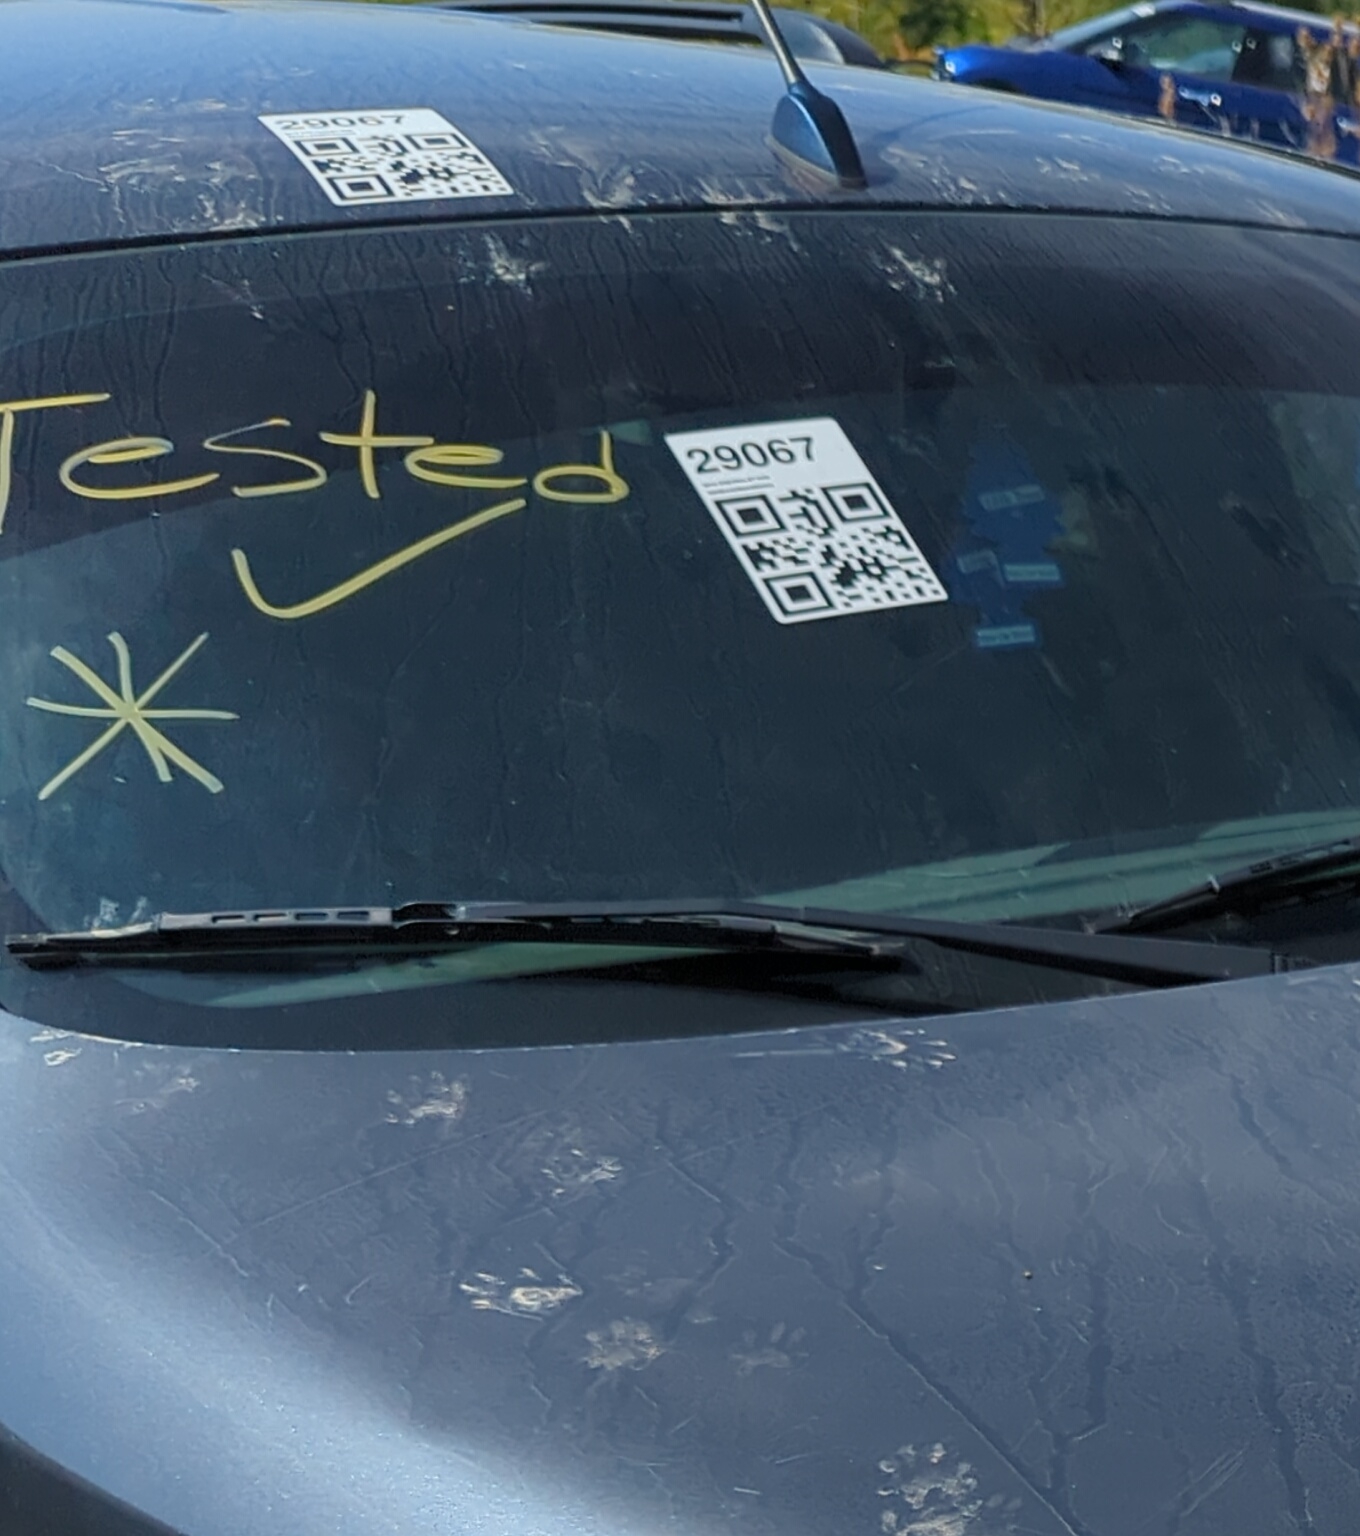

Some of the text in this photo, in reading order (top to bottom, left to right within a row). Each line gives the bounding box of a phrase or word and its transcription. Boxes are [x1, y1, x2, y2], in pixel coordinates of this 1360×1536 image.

[275, 114, 406, 131] 29067
[0, 389, 629, 535] Tested
[686, 436, 815, 474] 29067
